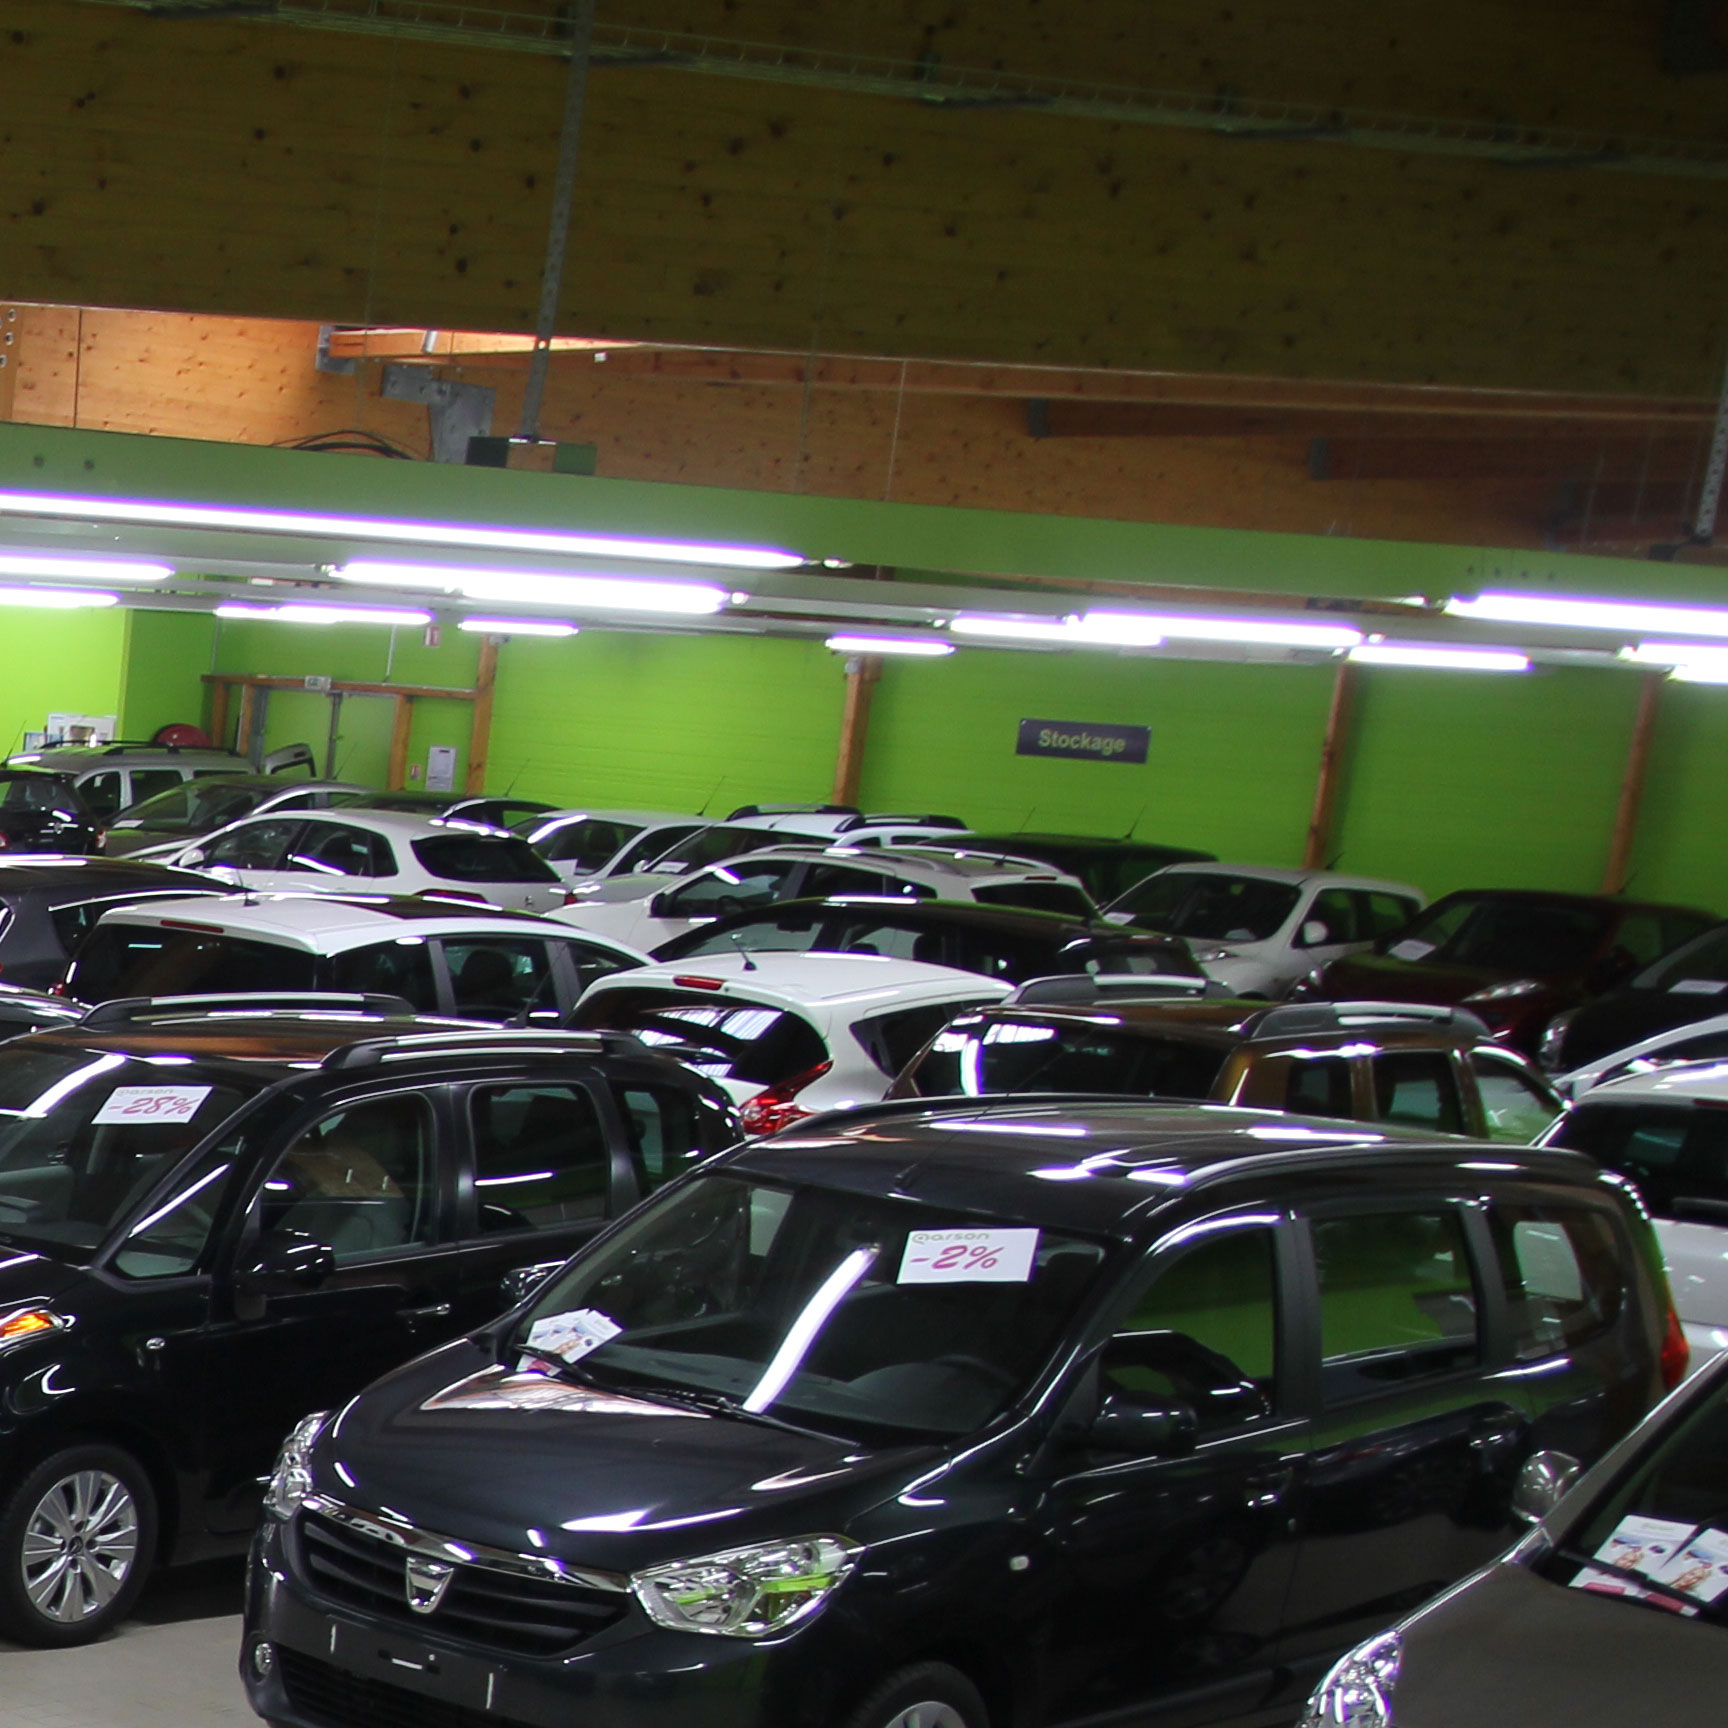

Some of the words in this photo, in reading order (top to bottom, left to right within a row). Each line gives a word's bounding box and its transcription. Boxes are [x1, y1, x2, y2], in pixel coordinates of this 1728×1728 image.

[1038, 729, 1126, 756] Stockage
[107, 1095, 200, 1115] -28%
[910, 1245, 1004, 1270] -2%
